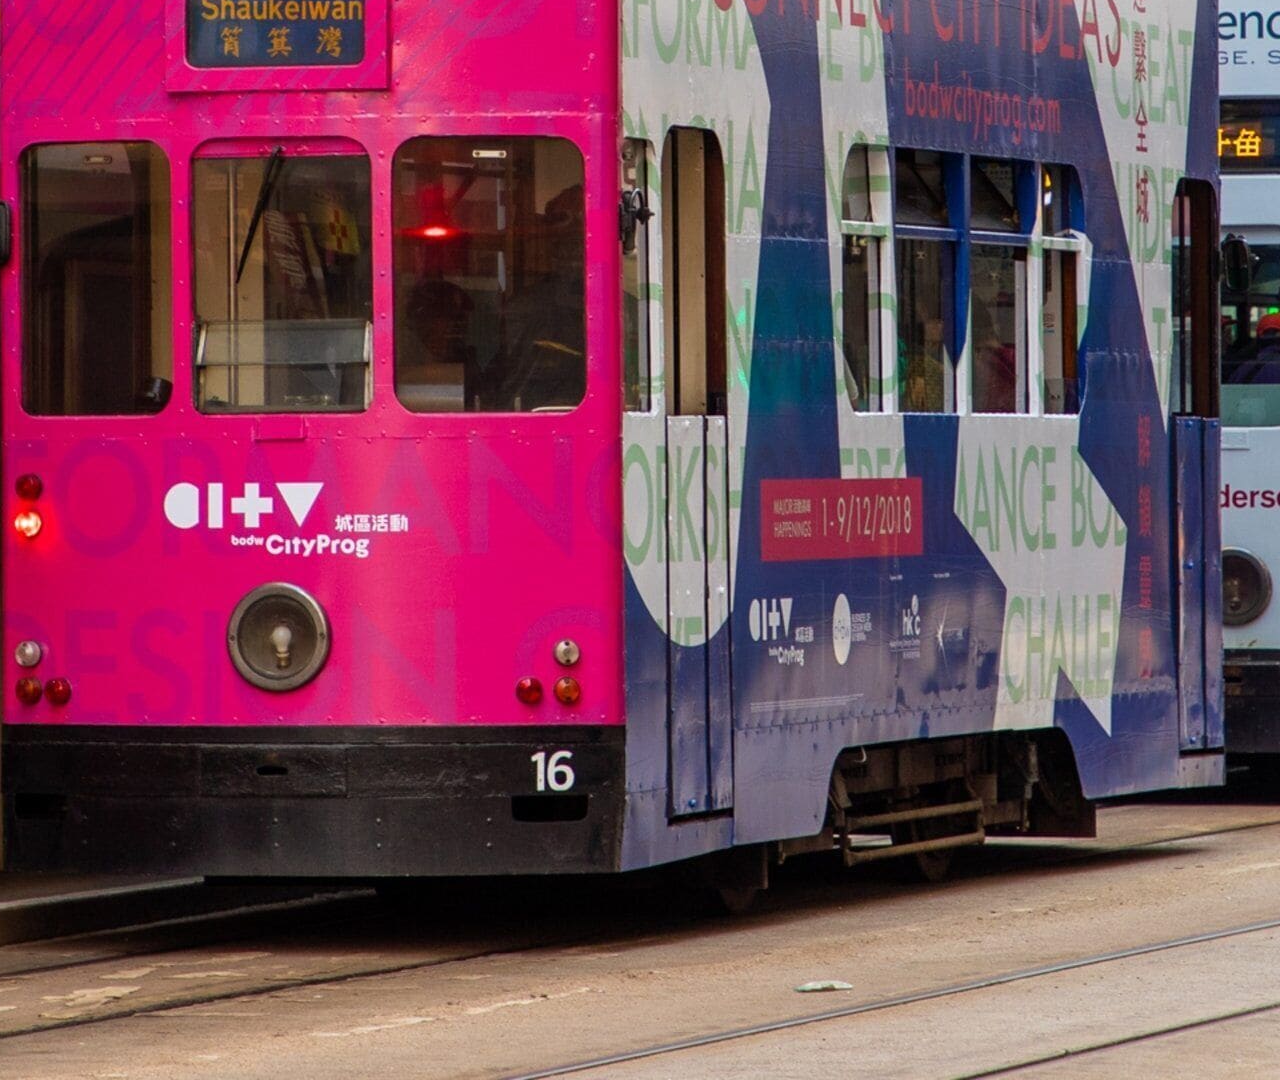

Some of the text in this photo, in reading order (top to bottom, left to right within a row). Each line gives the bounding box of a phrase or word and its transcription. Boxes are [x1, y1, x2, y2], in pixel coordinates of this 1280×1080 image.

[904, 56, 1061, 146] bodwcityprog.com
[334, 514, 410, 533] 城區活動
[230, 533, 371, 559] bodw CityProg
[531, 750, 575, 792] 16
